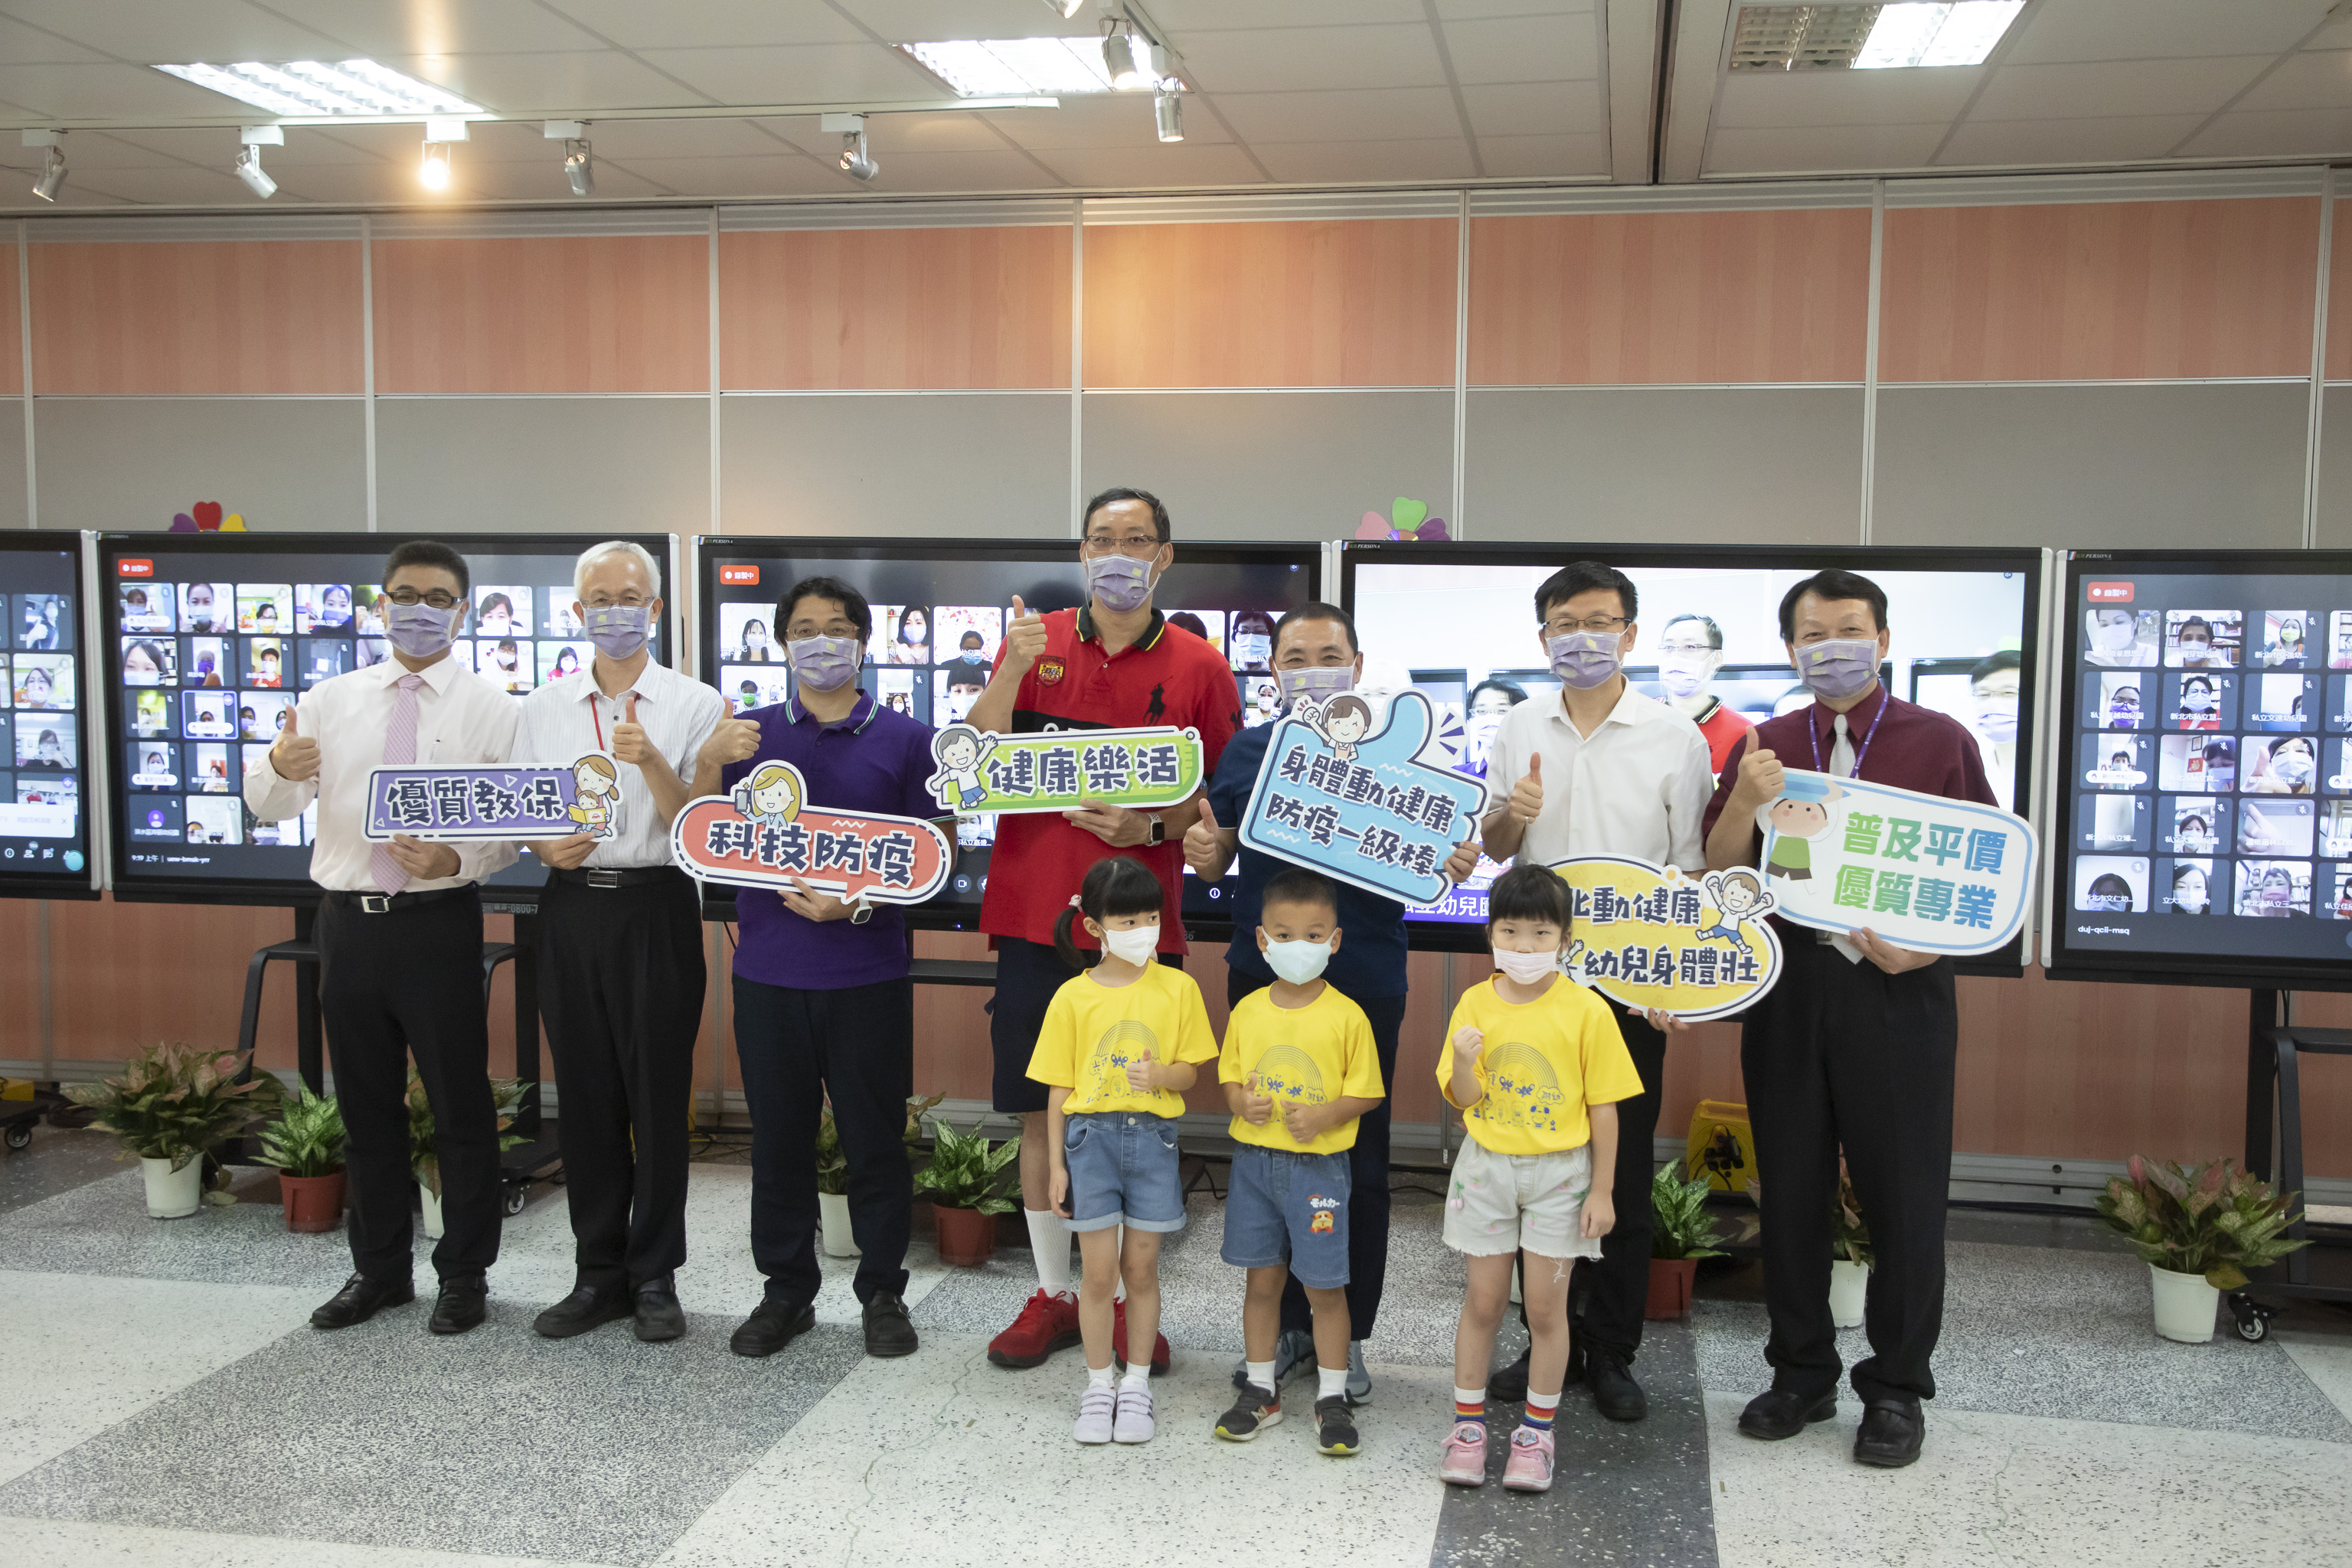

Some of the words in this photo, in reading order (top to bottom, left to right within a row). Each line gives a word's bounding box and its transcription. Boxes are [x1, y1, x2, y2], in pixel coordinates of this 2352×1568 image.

[987, 745, 1177, 794] 健康樂活
[1280, 745, 1455, 833] 身體動健康
[387, 779, 565, 826] 優質教保
[1266, 793, 1436, 875] 防疫一級棒
[707, 822, 916, 887] 科技防疫
[1844, 812, 2007, 875] 普及平價
[1833, 864, 1997, 929] 優質專業
[1585, 945, 1759, 985] 幼兒身體壯
